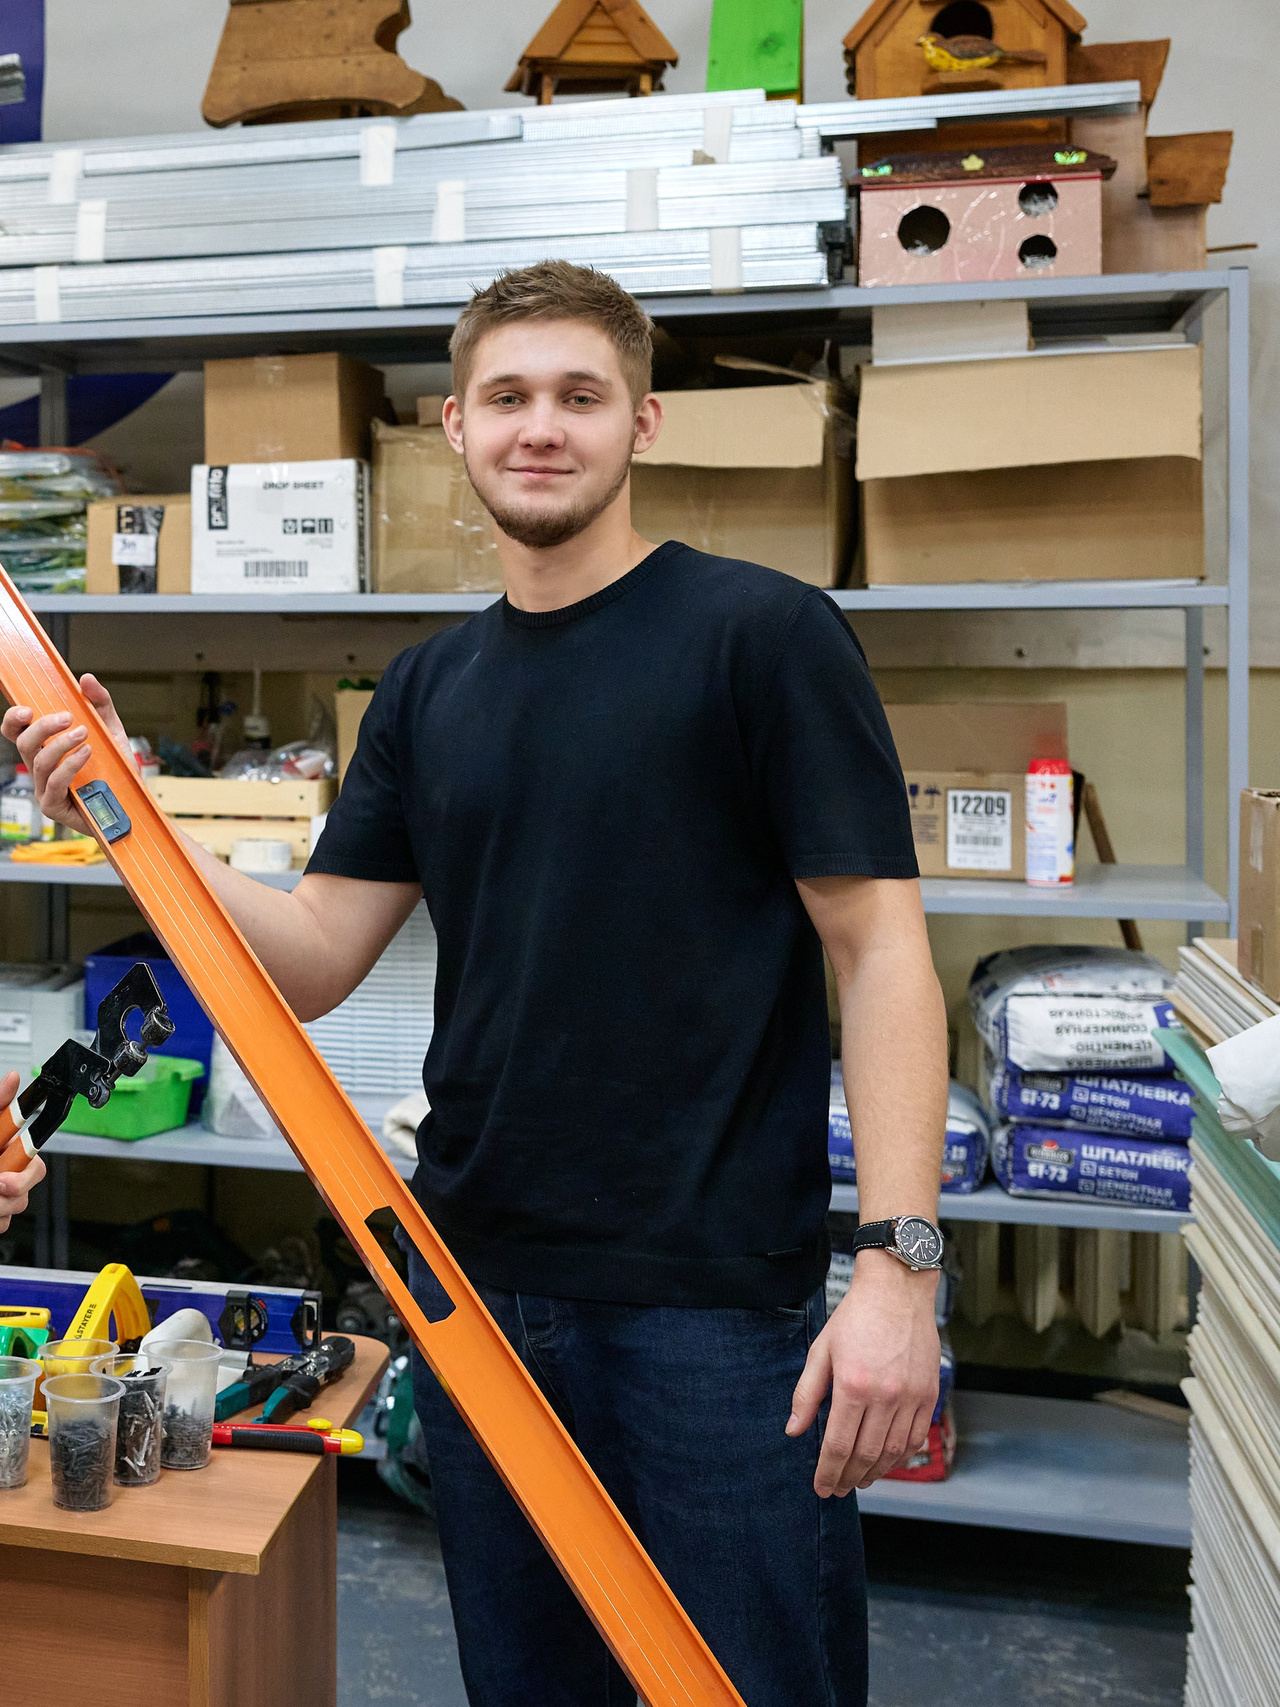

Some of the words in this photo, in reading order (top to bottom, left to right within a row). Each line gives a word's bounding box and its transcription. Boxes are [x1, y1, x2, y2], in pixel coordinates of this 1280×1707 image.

[951, 795, 1007, 816] 12209
[1075, 1076, 1190, 1106] ШПАТЛЕВКА
[1090, 1092, 1130, 1110] БЕТОН
[1098, 1166, 1138, 1181] БЕТОН
[75, 1306, 94, 1336] STAYER
